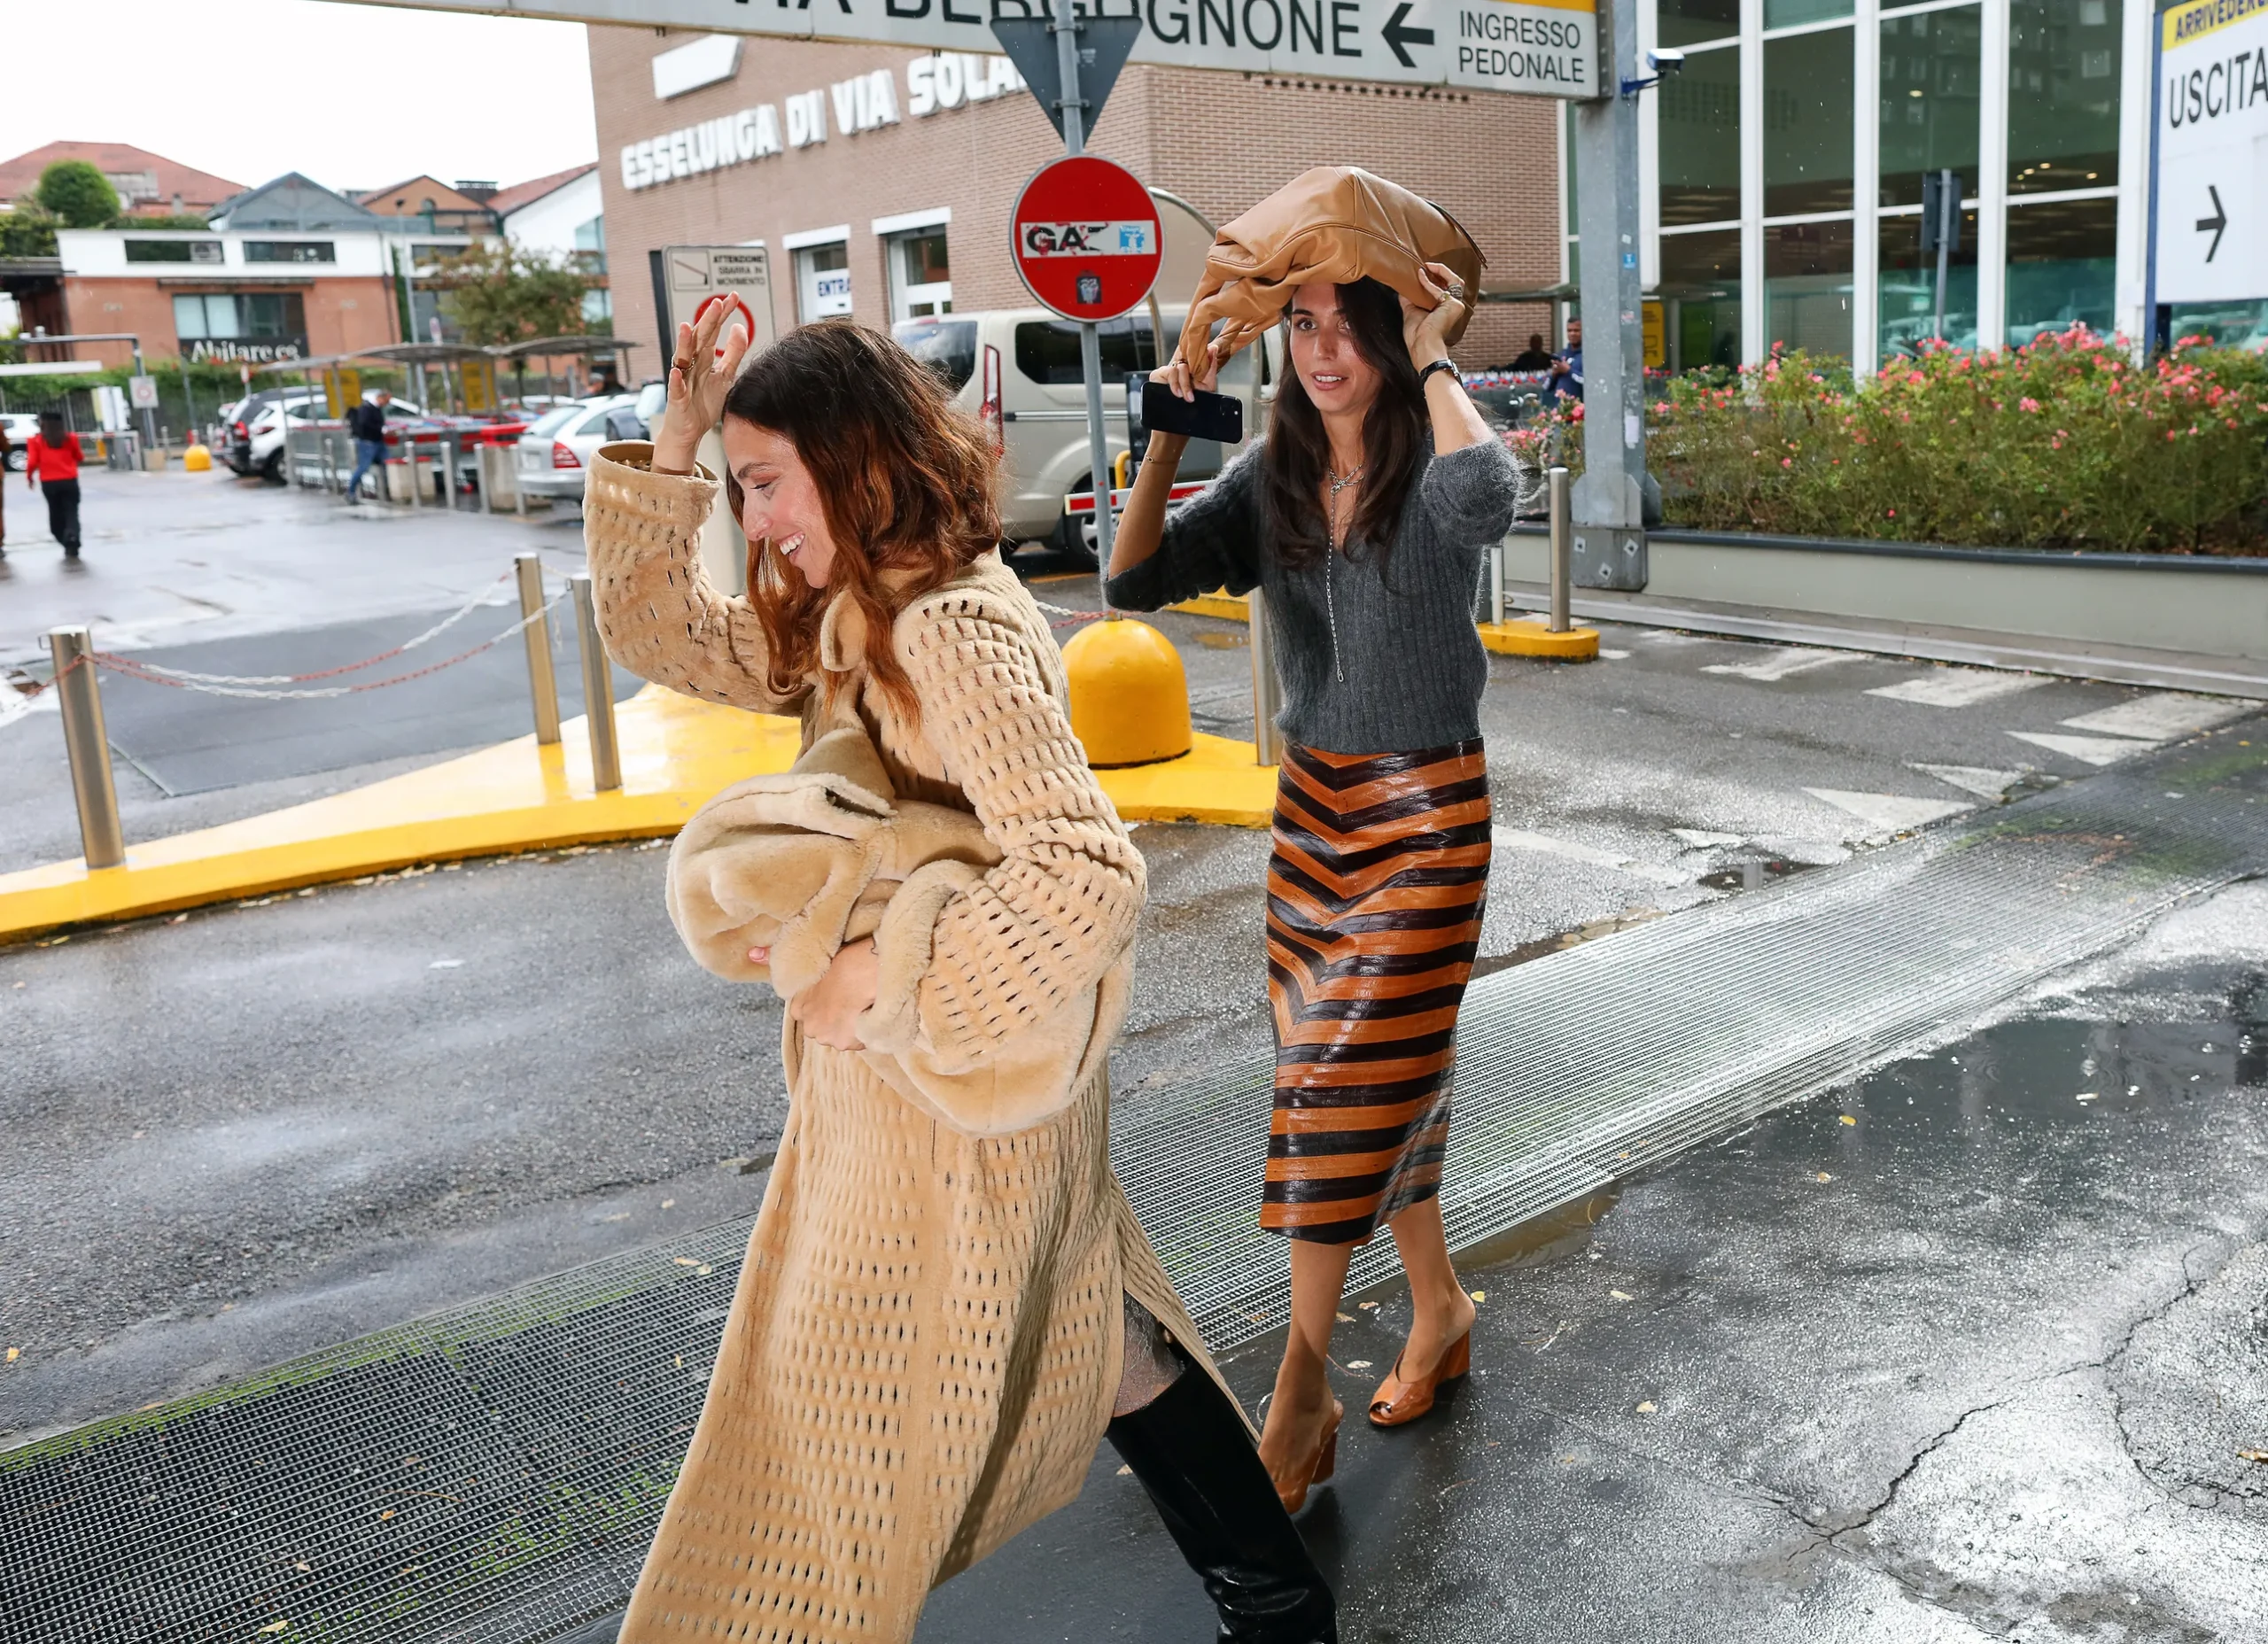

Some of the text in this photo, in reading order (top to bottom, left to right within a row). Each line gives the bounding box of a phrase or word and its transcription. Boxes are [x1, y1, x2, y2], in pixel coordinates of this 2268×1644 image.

[1460, 10, 1581, 49] INGRESSO
[1458, 46, 1585, 83] PEDONALE
[2169, 46, 2268, 128] USCITA
[620, 50, 1028, 190] ESSELUNGA DI VIA SOLA
